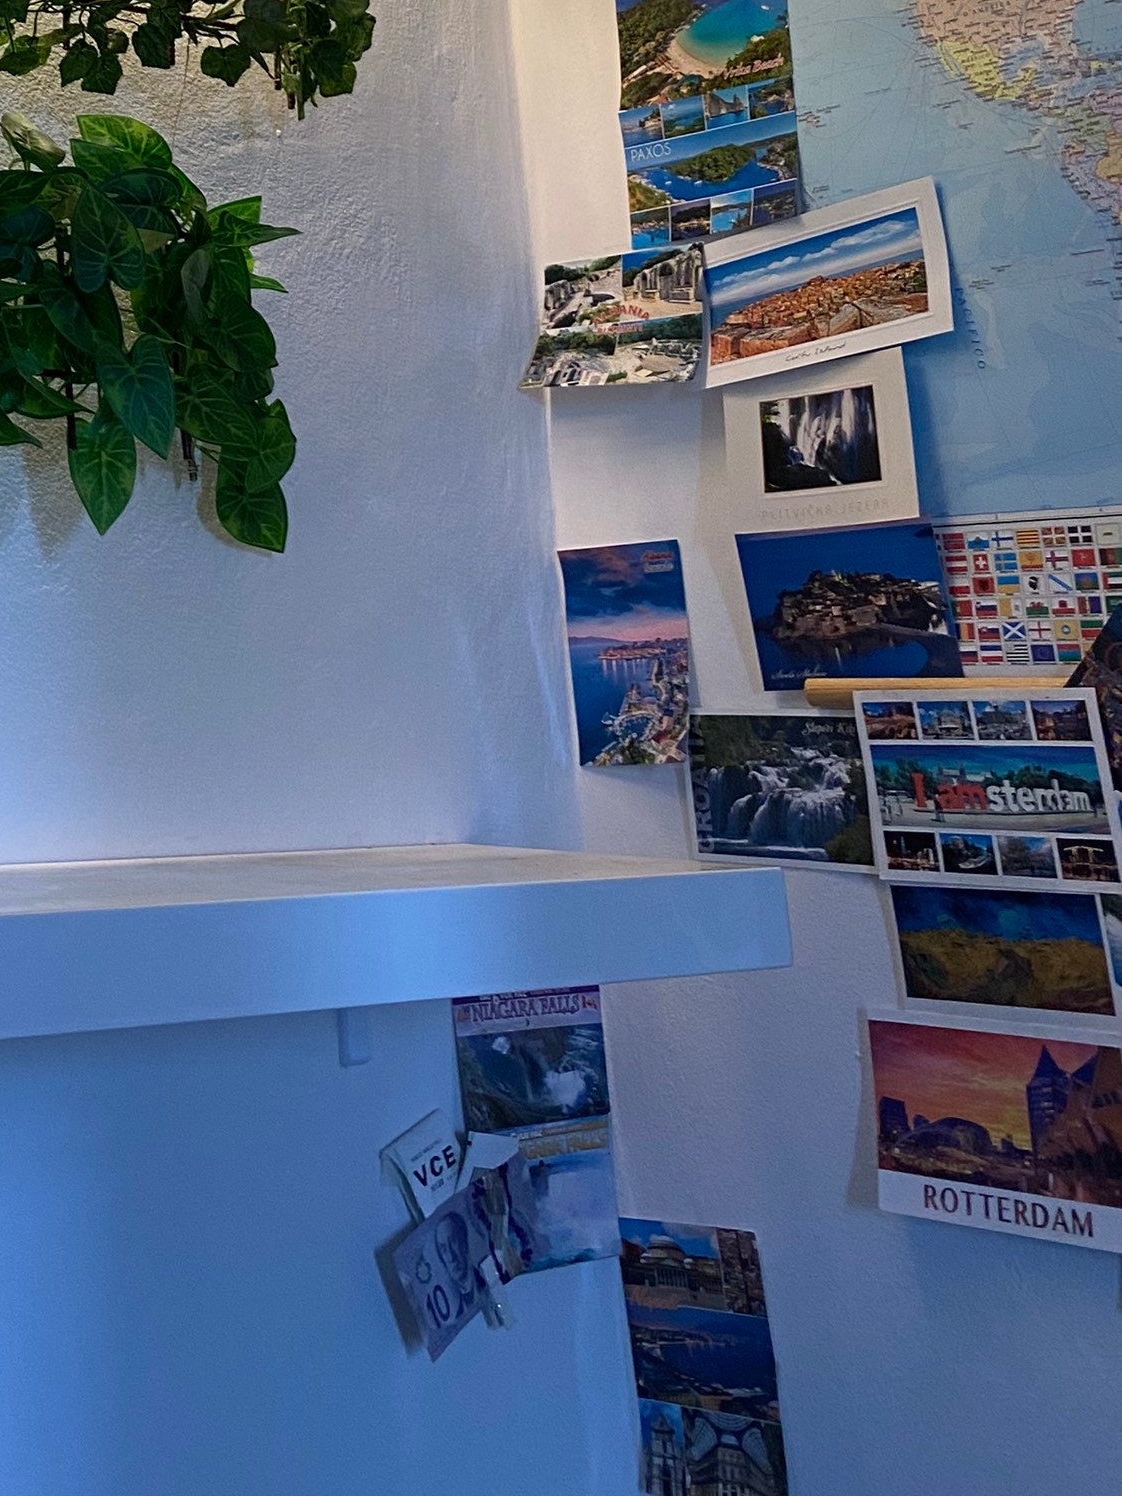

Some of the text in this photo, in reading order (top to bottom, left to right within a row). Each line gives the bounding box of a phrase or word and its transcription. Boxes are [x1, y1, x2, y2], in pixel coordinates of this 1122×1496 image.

[631, 142, 671, 162] PAXOS
[593, 304, 650, 327] ALBANIA
[469, 999, 538, 1022] NIAGARA
[539, 994, 580, 1015] FALLS
[413, 1145, 456, 1186] VCE
[923, 1184, 1094, 1237] ROTTERDAM
[426, 1284, 450, 1328] 10
